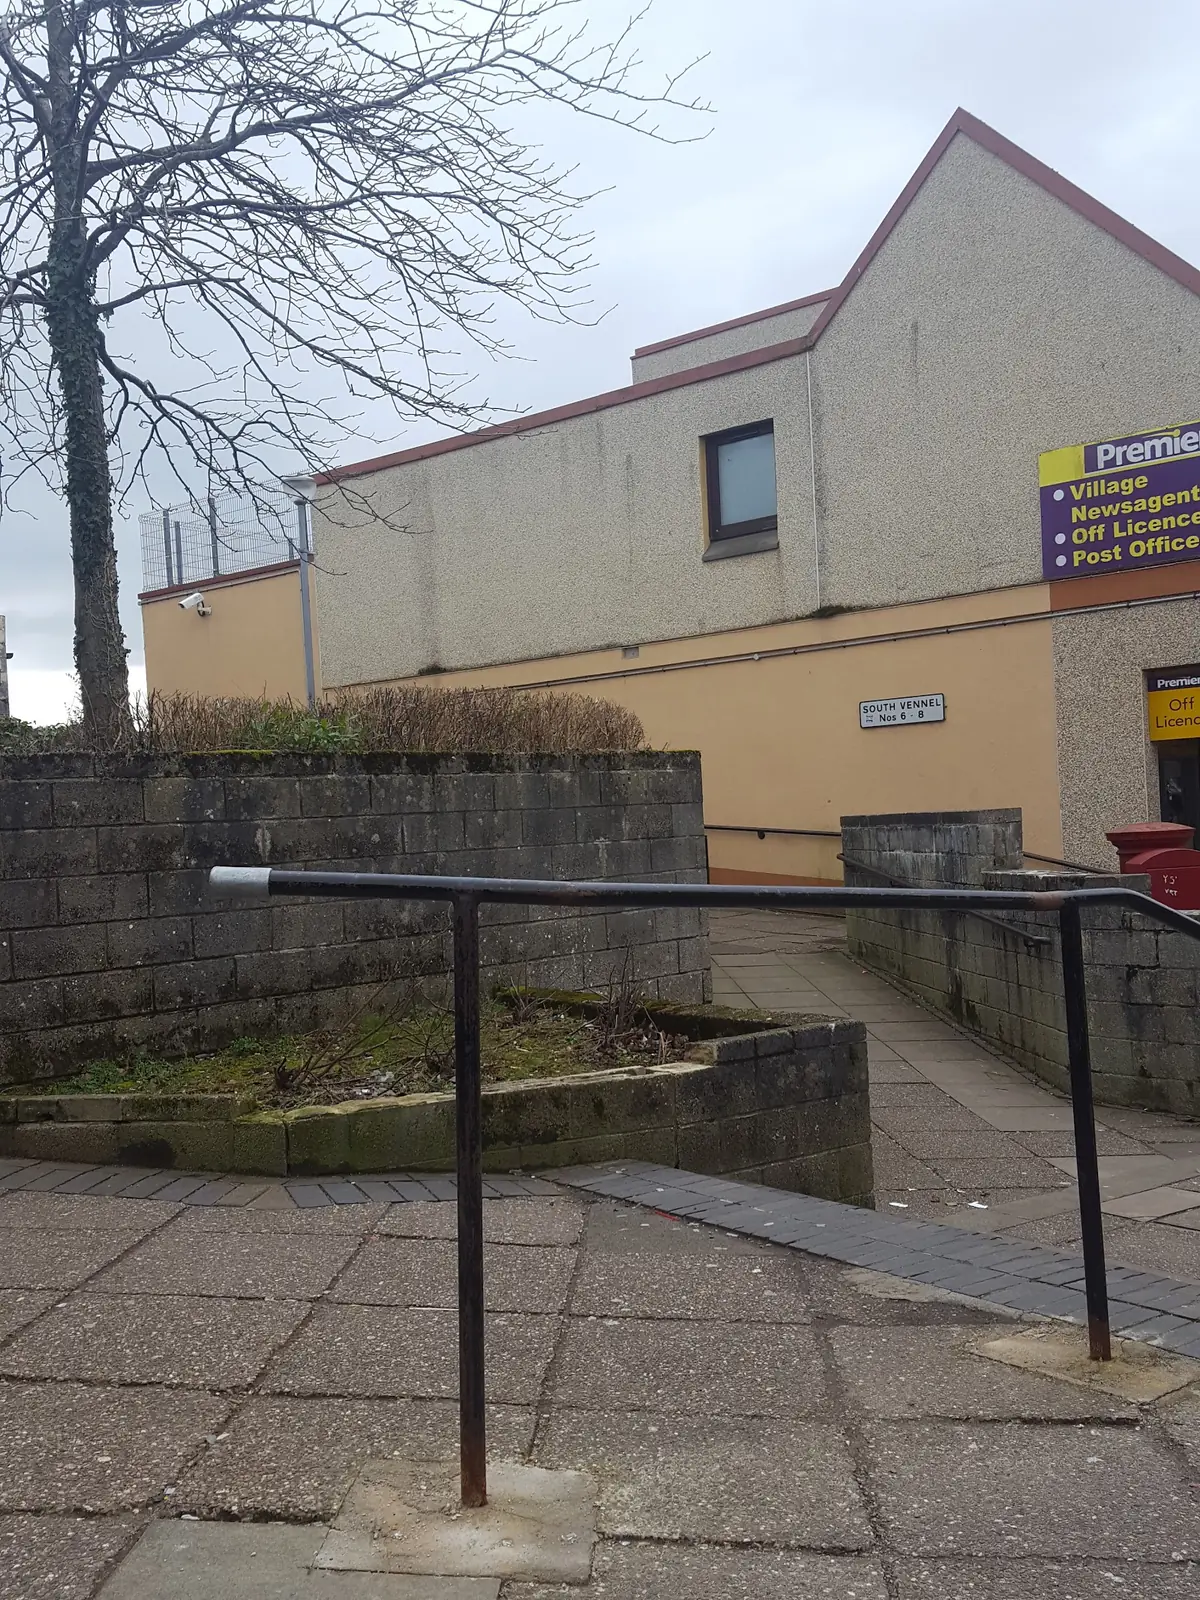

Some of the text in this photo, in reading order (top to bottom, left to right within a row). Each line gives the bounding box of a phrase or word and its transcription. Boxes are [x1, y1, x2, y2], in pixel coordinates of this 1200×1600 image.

[1097, 429, 1200, 469] Premie
[1070, 475, 1148, 500] Village
[1072, 511, 1200, 545] Off Licence
[1073, 535, 1200, 567] Post Office
[862, 698, 941, 714] SOUTH VENNEL
[879, 713, 897, 722] Nos
[900, 711, 906, 720] 6
[918, 710, 924, 719] 8
[1169, 696, 1195, 711] Off
